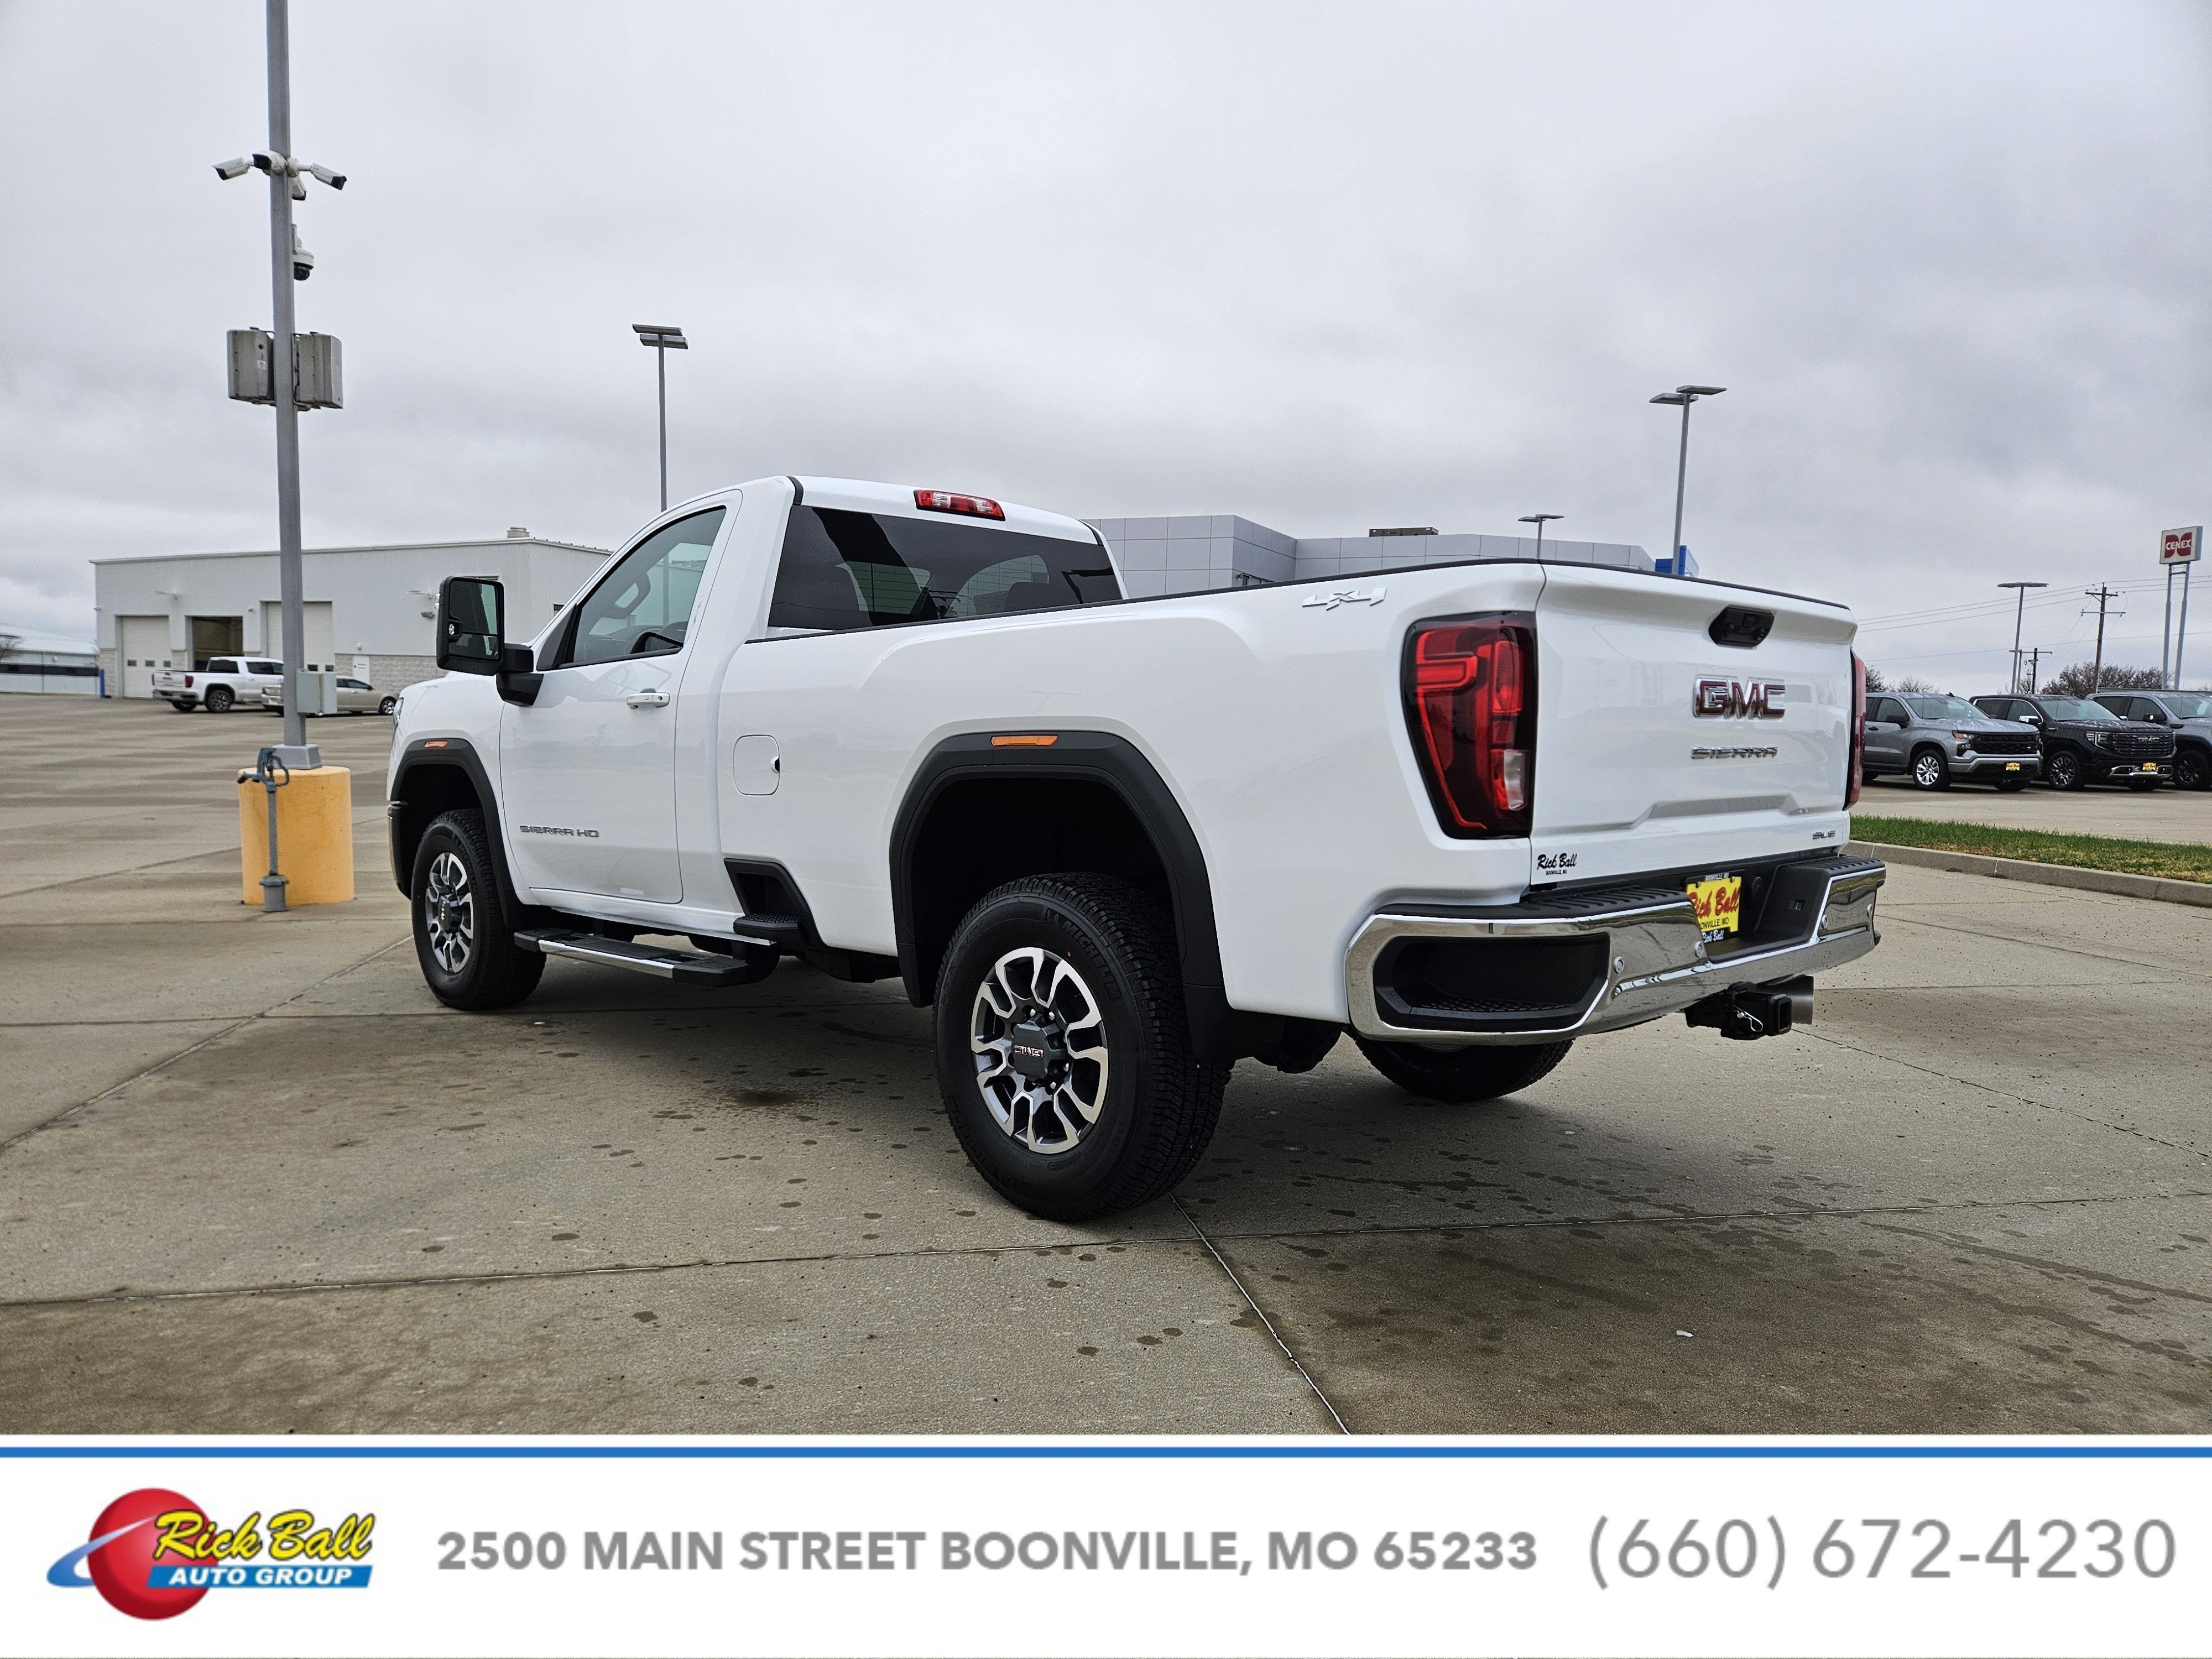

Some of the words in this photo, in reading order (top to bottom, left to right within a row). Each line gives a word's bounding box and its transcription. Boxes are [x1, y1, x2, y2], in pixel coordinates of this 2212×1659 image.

[2166, 540, 2191, 550] CENEX
[1693, 677, 1786, 719] GMC
[1691, 746, 1777, 759] SIERRA
[519, 825, 574, 836] SIERRA
[577, 829, 599, 838] HD
[1813, 830, 1836, 839] SLE
[1537, 854, 1557, 870] Rick
[1559, 853, 1577, 868] Ball
[1715, 886, 1741, 916] Ball
[1713, 929, 1724, 941] Ball
[1060, 919, 1123, 998] MICHELIN
[1014, 1045, 1044, 1058] GMC
